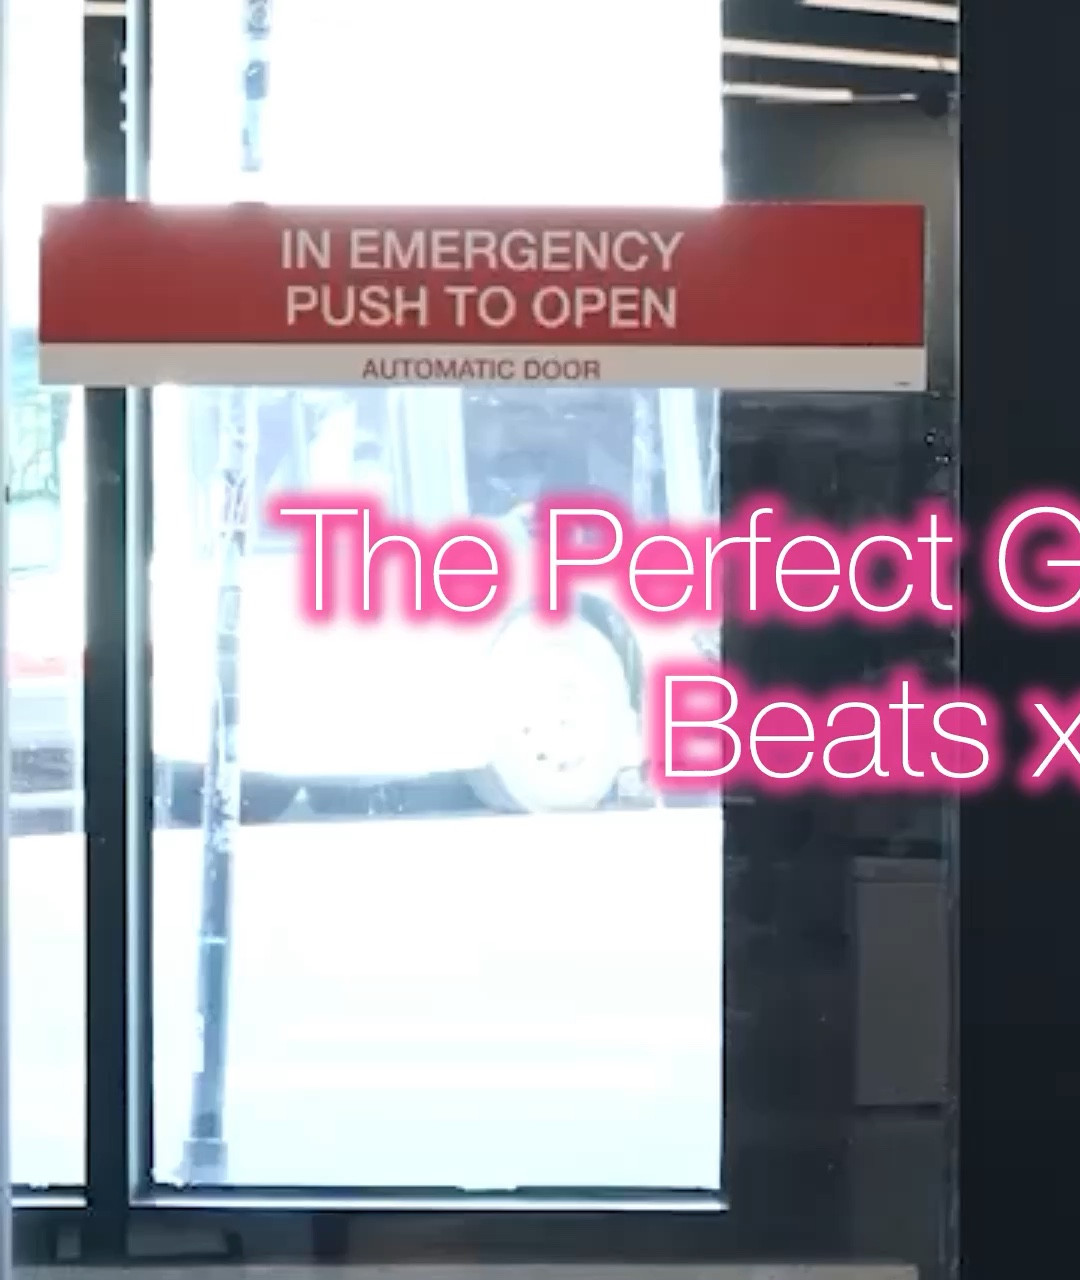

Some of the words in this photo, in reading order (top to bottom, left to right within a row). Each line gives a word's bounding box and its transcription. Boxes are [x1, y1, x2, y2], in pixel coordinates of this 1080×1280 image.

[281, 228, 332, 269] IN
[350, 228, 685, 272] EMERGENCY
[286, 284, 429, 328] PUSH
[443, 285, 517, 329] TO
[532, 285, 677, 330] OPEN
[362, 357, 515, 380] AUTOMATIC
[523, 359, 601, 381] DOOR
